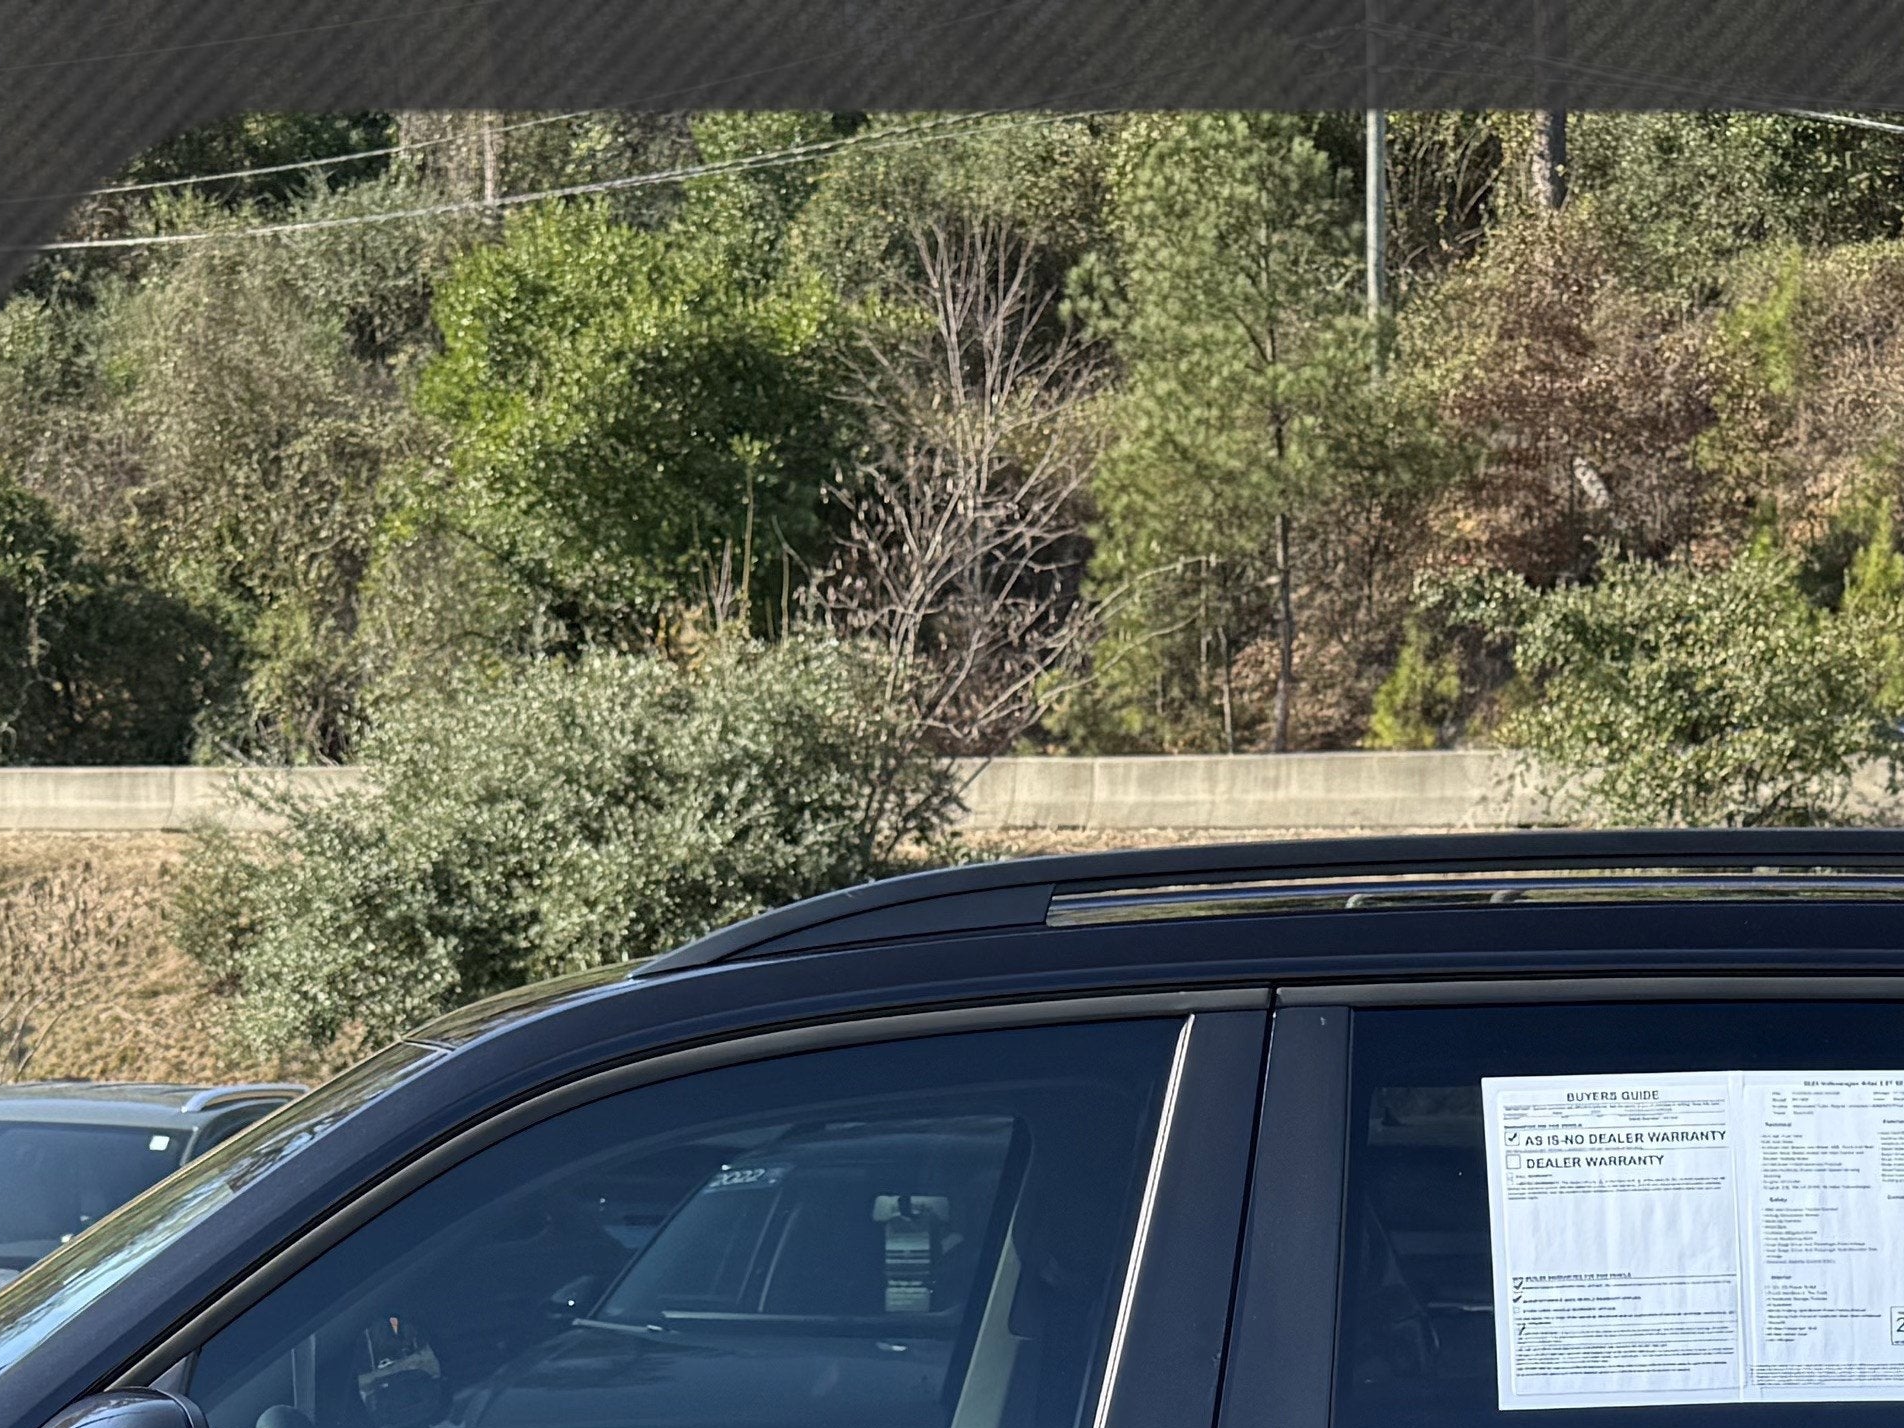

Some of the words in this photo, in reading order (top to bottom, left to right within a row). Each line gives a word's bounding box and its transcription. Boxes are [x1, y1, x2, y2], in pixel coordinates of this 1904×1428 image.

[1566, 1091, 1617, 1102] BUYERS
[1621, 1090, 1660, 1101] GUIDE
[1524, 1136, 1543, 1146] AS
[1588, 1132, 1645, 1144] DEALER
[1647, 1130, 1727, 1143] WARRANTY
[1526, 1157, 1582, 1169] DEALER
[1585, 1155, 1665, 1167] WARRANTY
